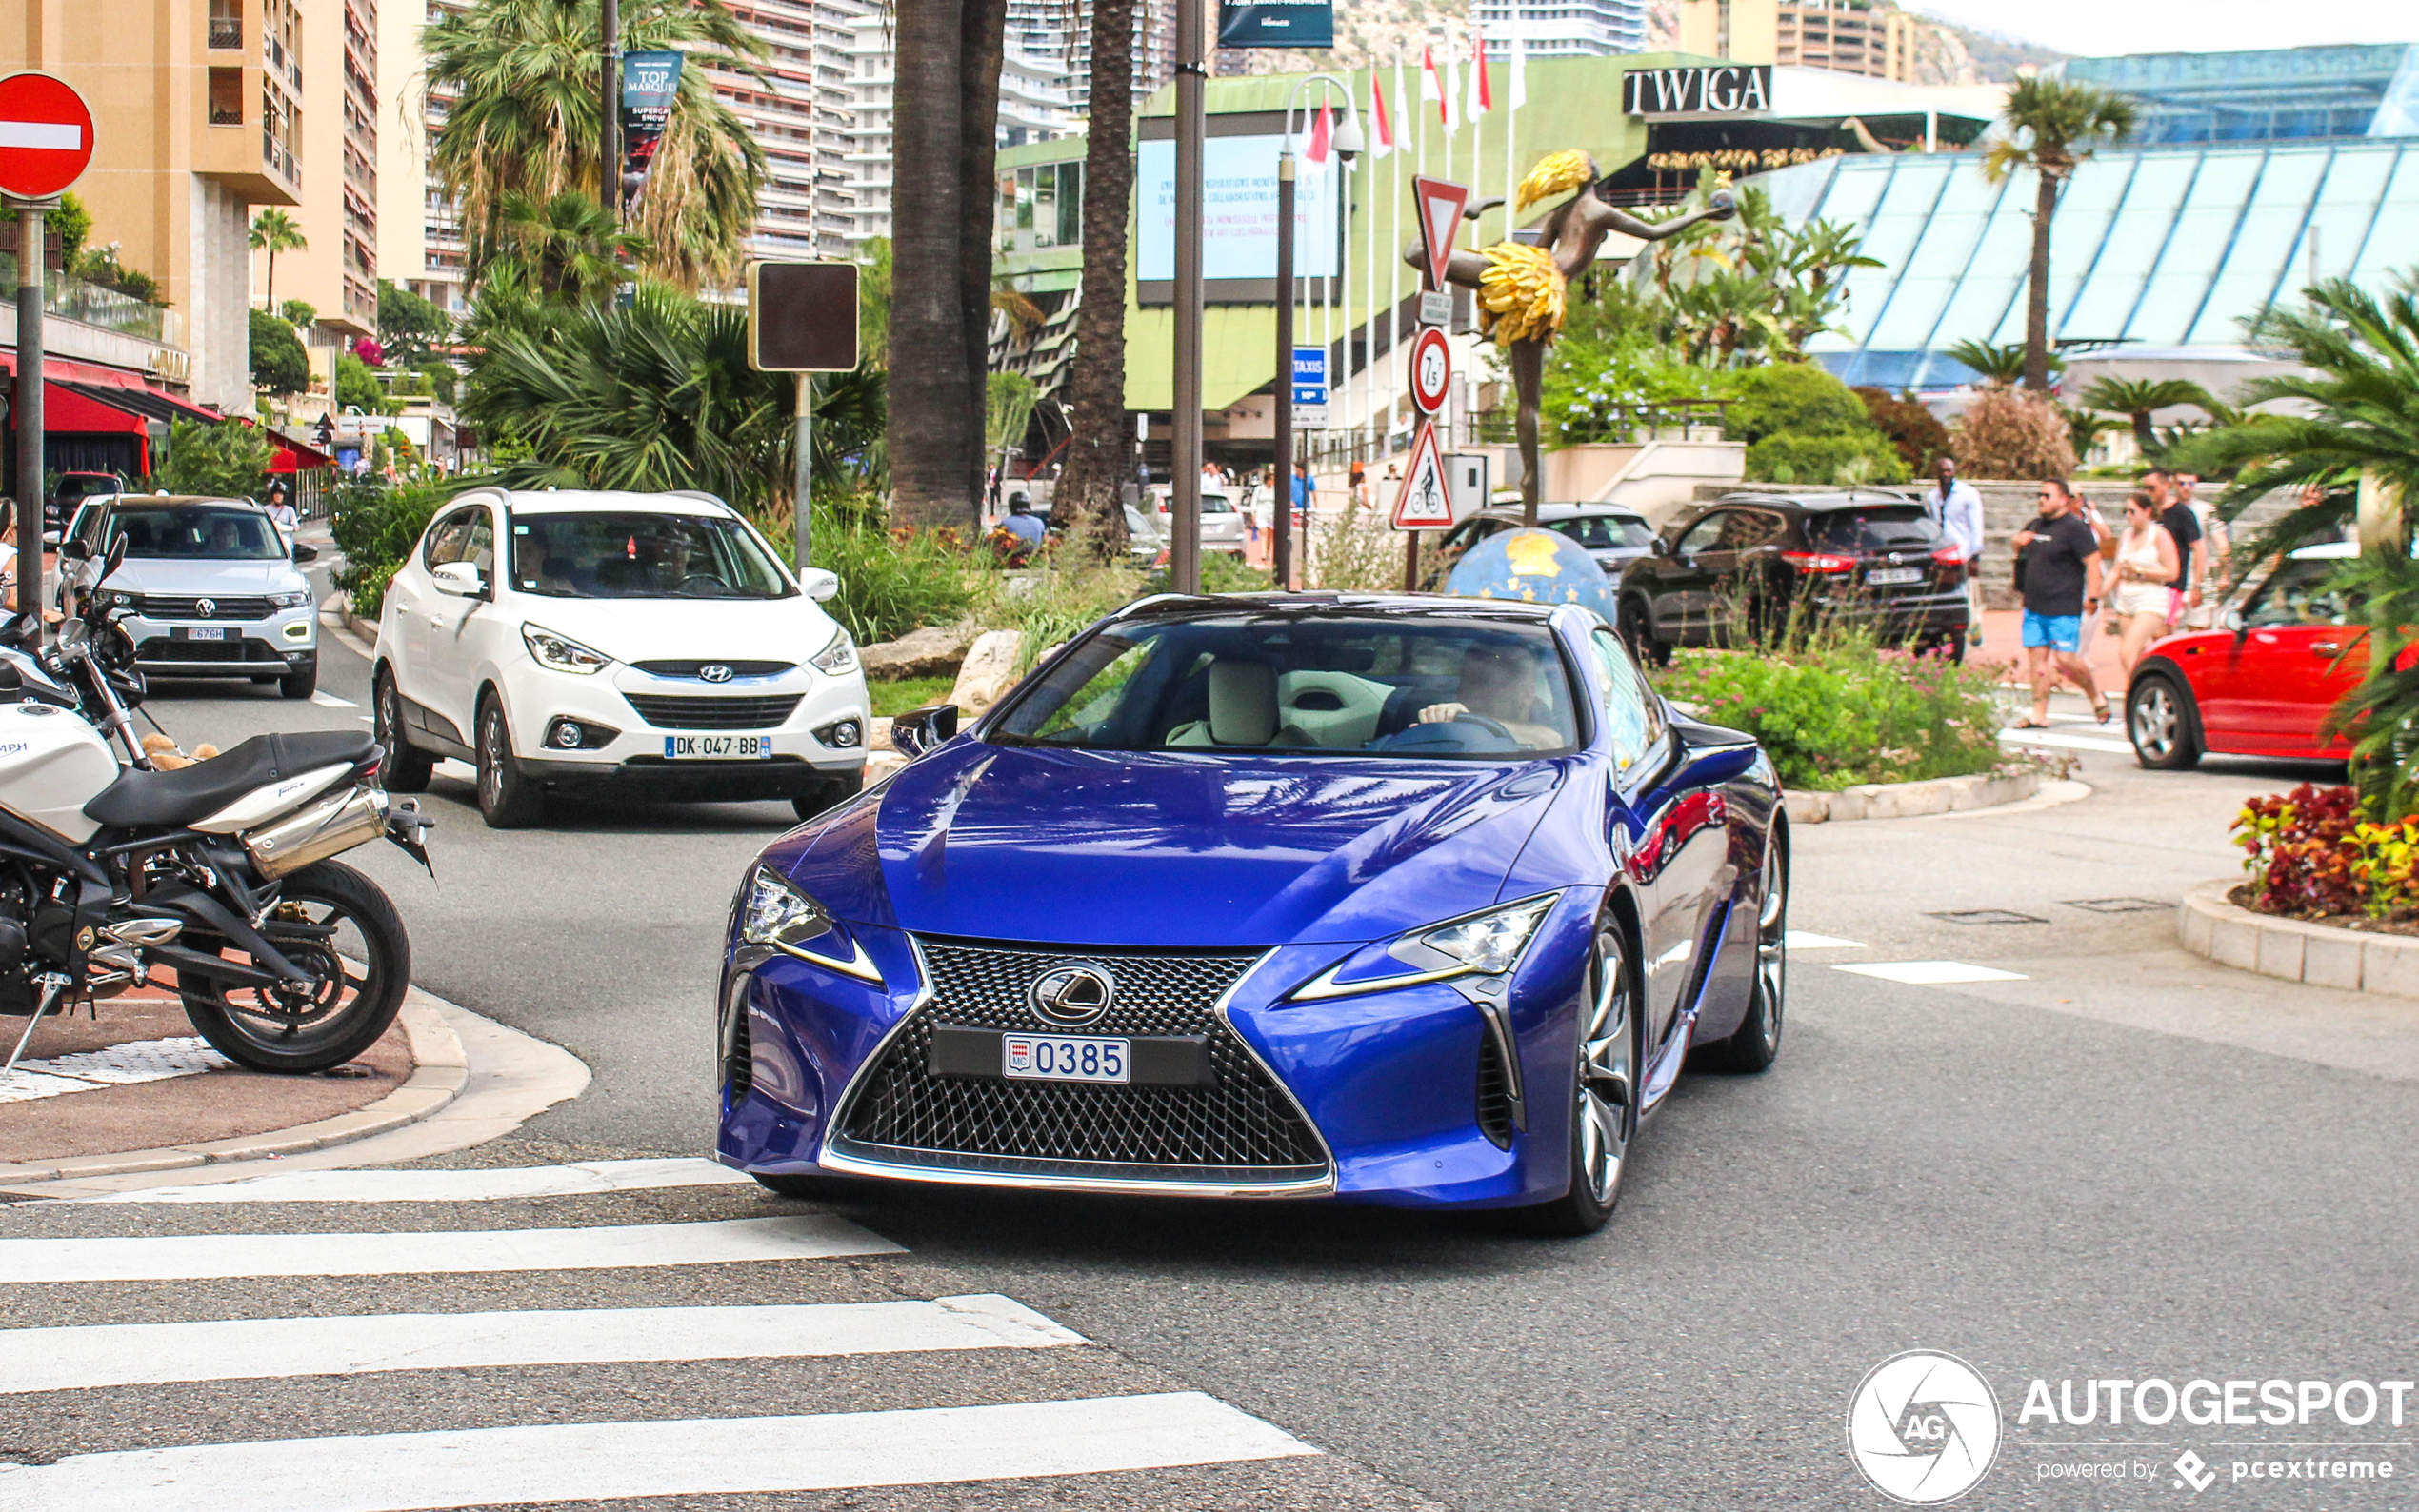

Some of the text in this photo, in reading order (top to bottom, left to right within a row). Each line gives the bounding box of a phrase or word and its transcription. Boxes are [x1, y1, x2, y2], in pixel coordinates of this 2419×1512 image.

[638, 70, 669, 84] TOP
[1623, 67, 1769, 115] TWIGA
[1292, 359, 1323, 373] TAXIS
[1012, 1041, 1122, 1076] MC 0385
